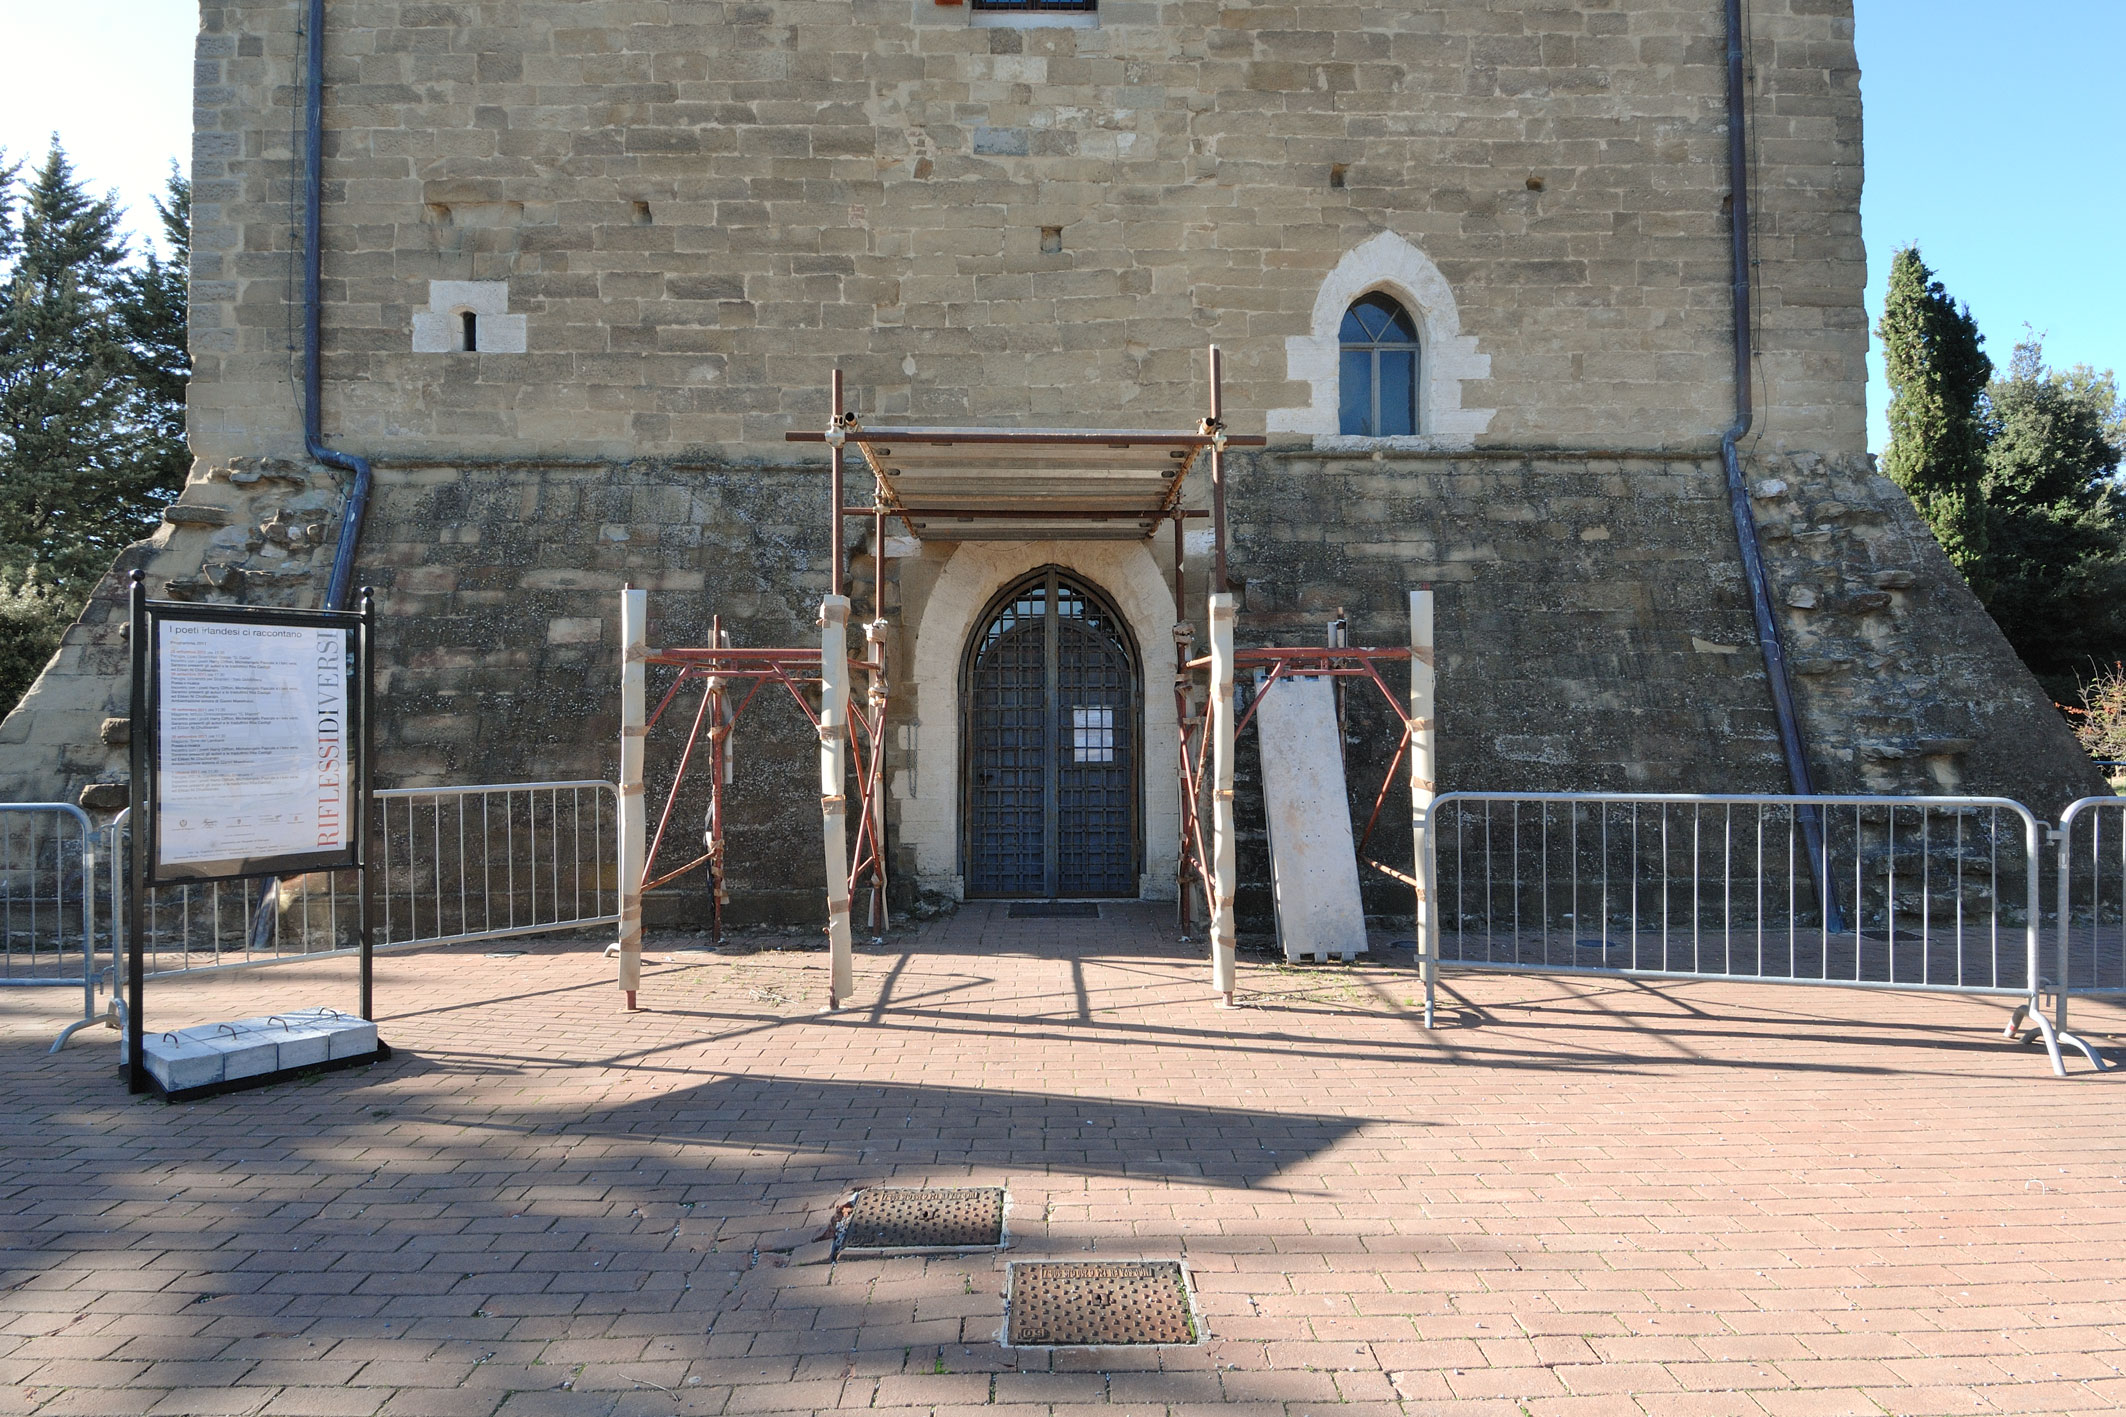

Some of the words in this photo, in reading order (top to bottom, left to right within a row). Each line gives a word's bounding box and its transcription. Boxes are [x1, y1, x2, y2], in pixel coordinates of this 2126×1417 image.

[169, 625, 173, 633] I
[175, 626, 199, 635] poeti
[202, 627, 240, 636] irlandesi
[242, 628, 251, 636] ci
[252, 630, 303, 638] raccontano
